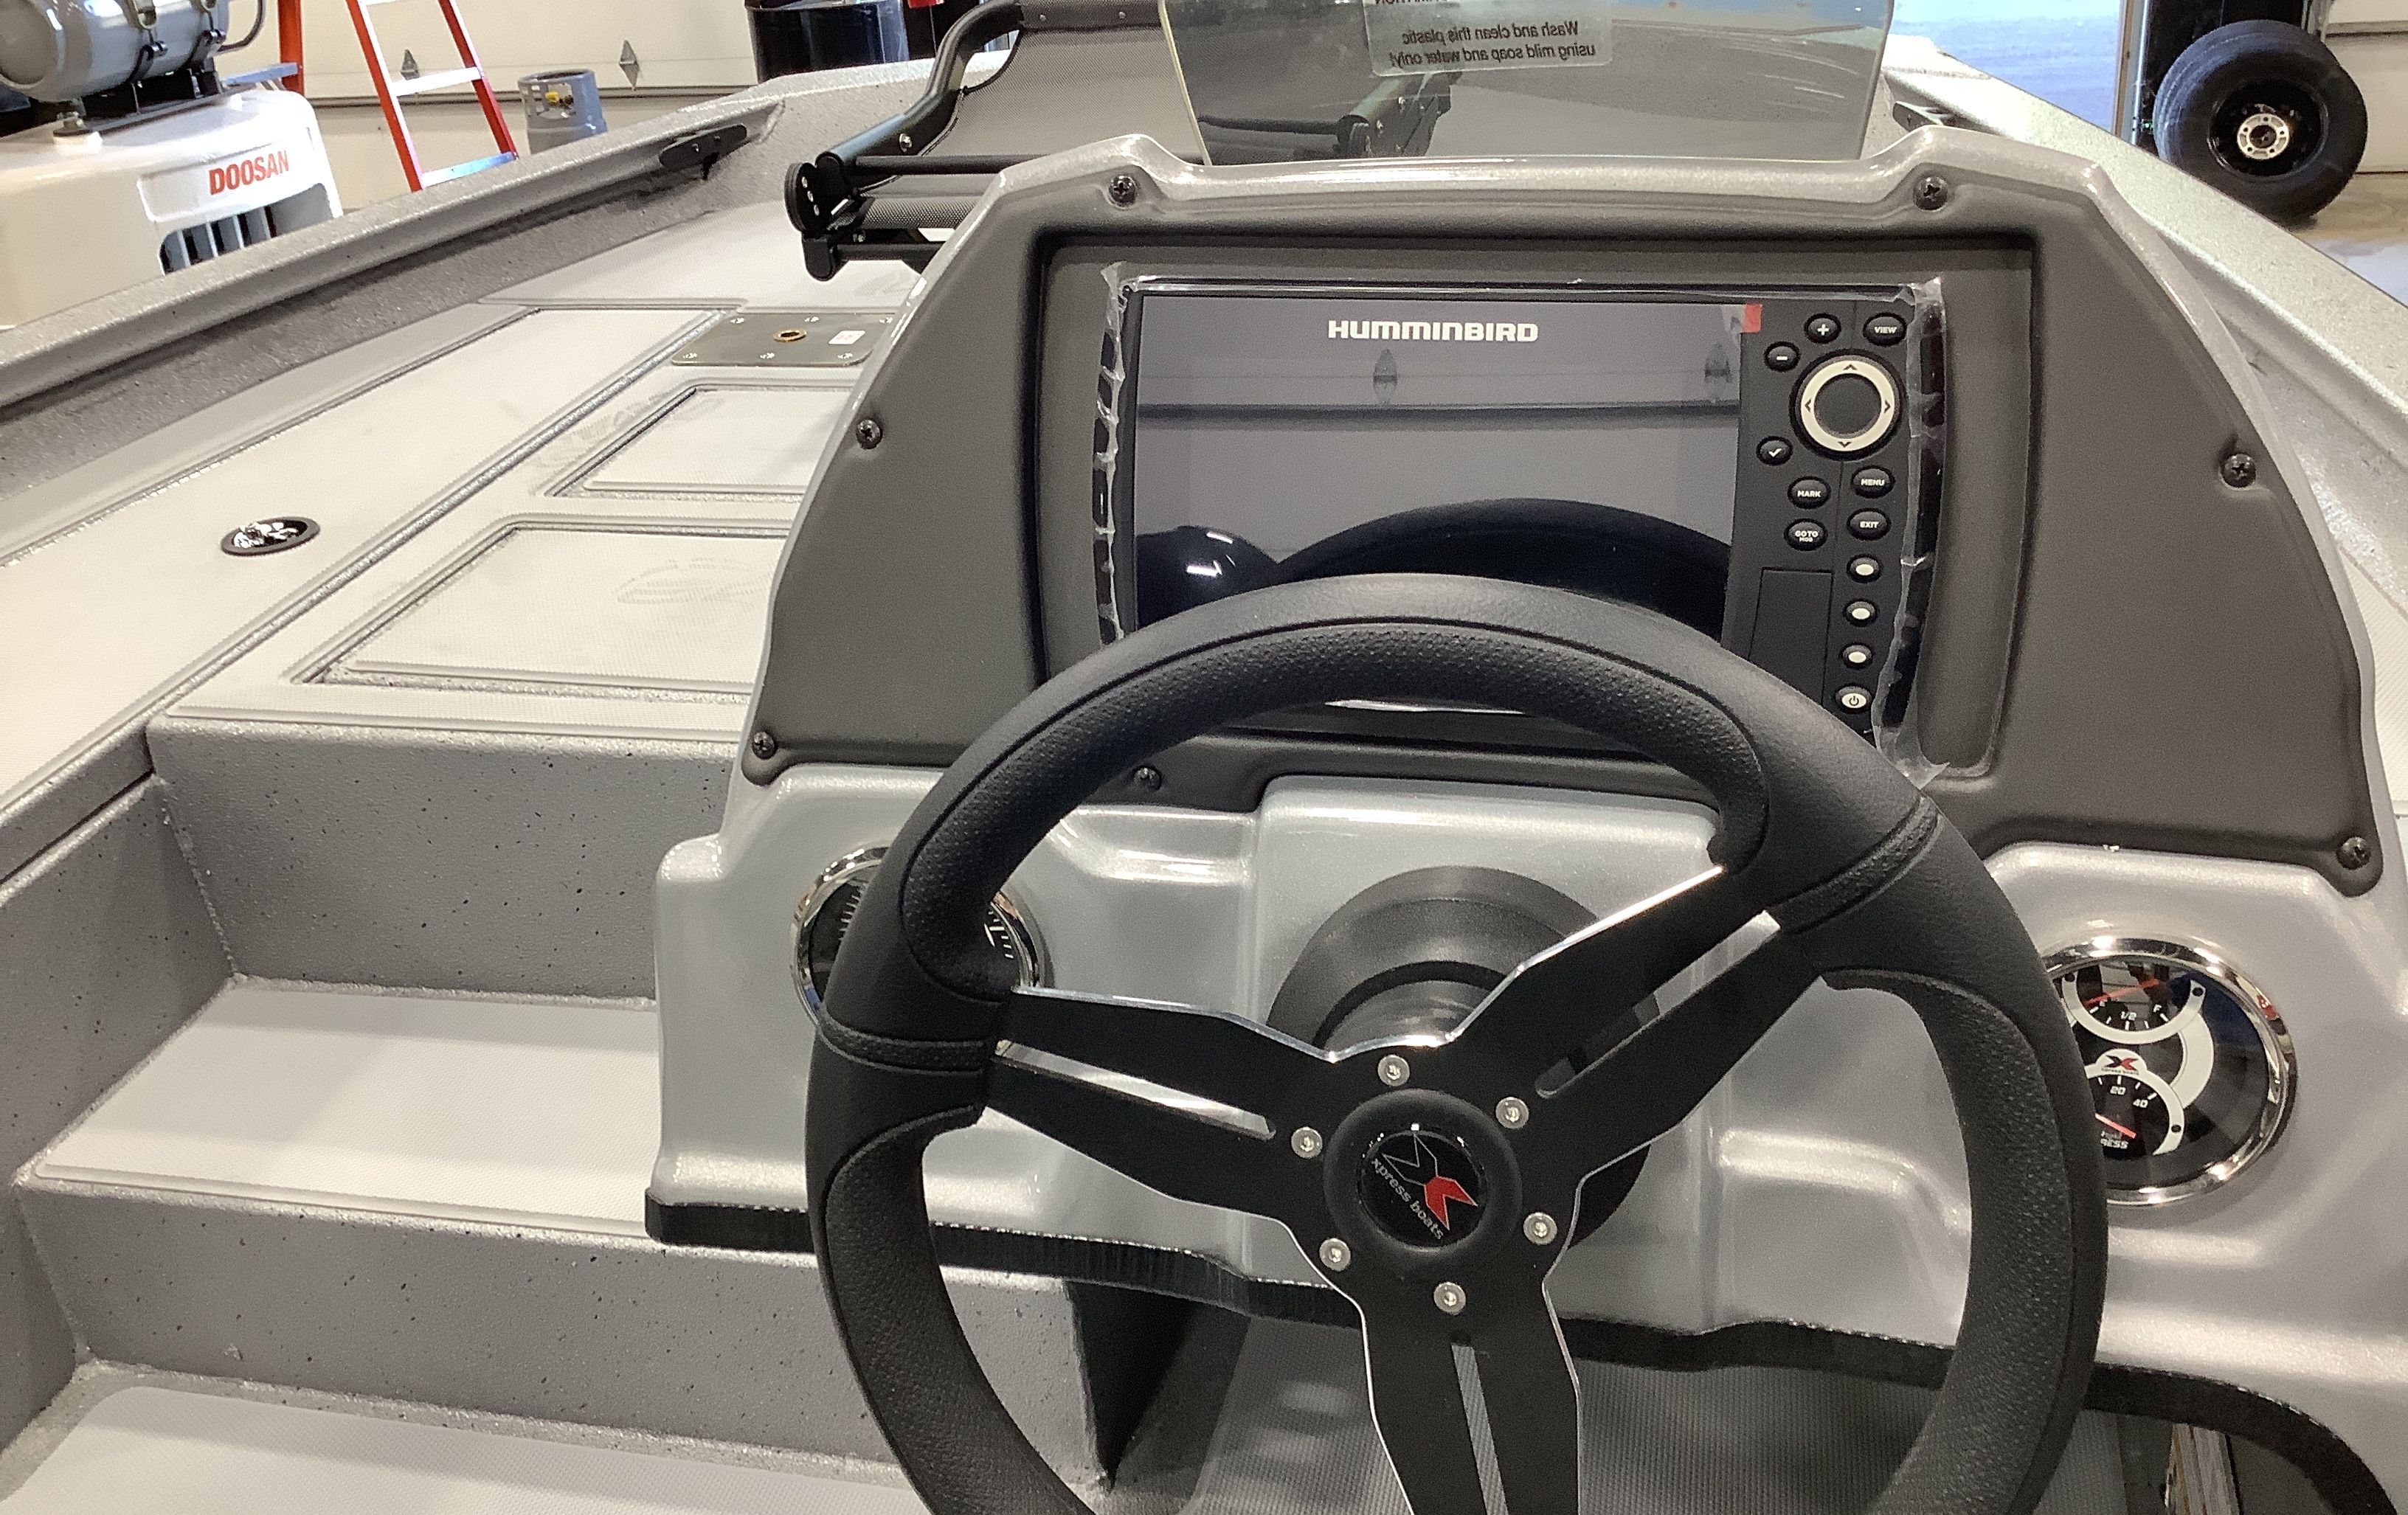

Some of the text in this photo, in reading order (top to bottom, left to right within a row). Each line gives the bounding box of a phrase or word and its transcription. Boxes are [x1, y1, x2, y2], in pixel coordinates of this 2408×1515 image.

[209, 150, 289, 195] DOOSAN
[1328, 320, 1539, 342] HUMMINBIRD
[1874, 326, 1897, 334] VIEW
[1797, 490, 1821, 498] MARK
[1860, 521, 1879, 529] EXIT
[2153, 1004, 2162, 1013] F
[2110, 1086, 2125, 1095] 20
[2133, 1100, 2148, 1108] 40
[1410, 1200, 1443, 1240] boats
